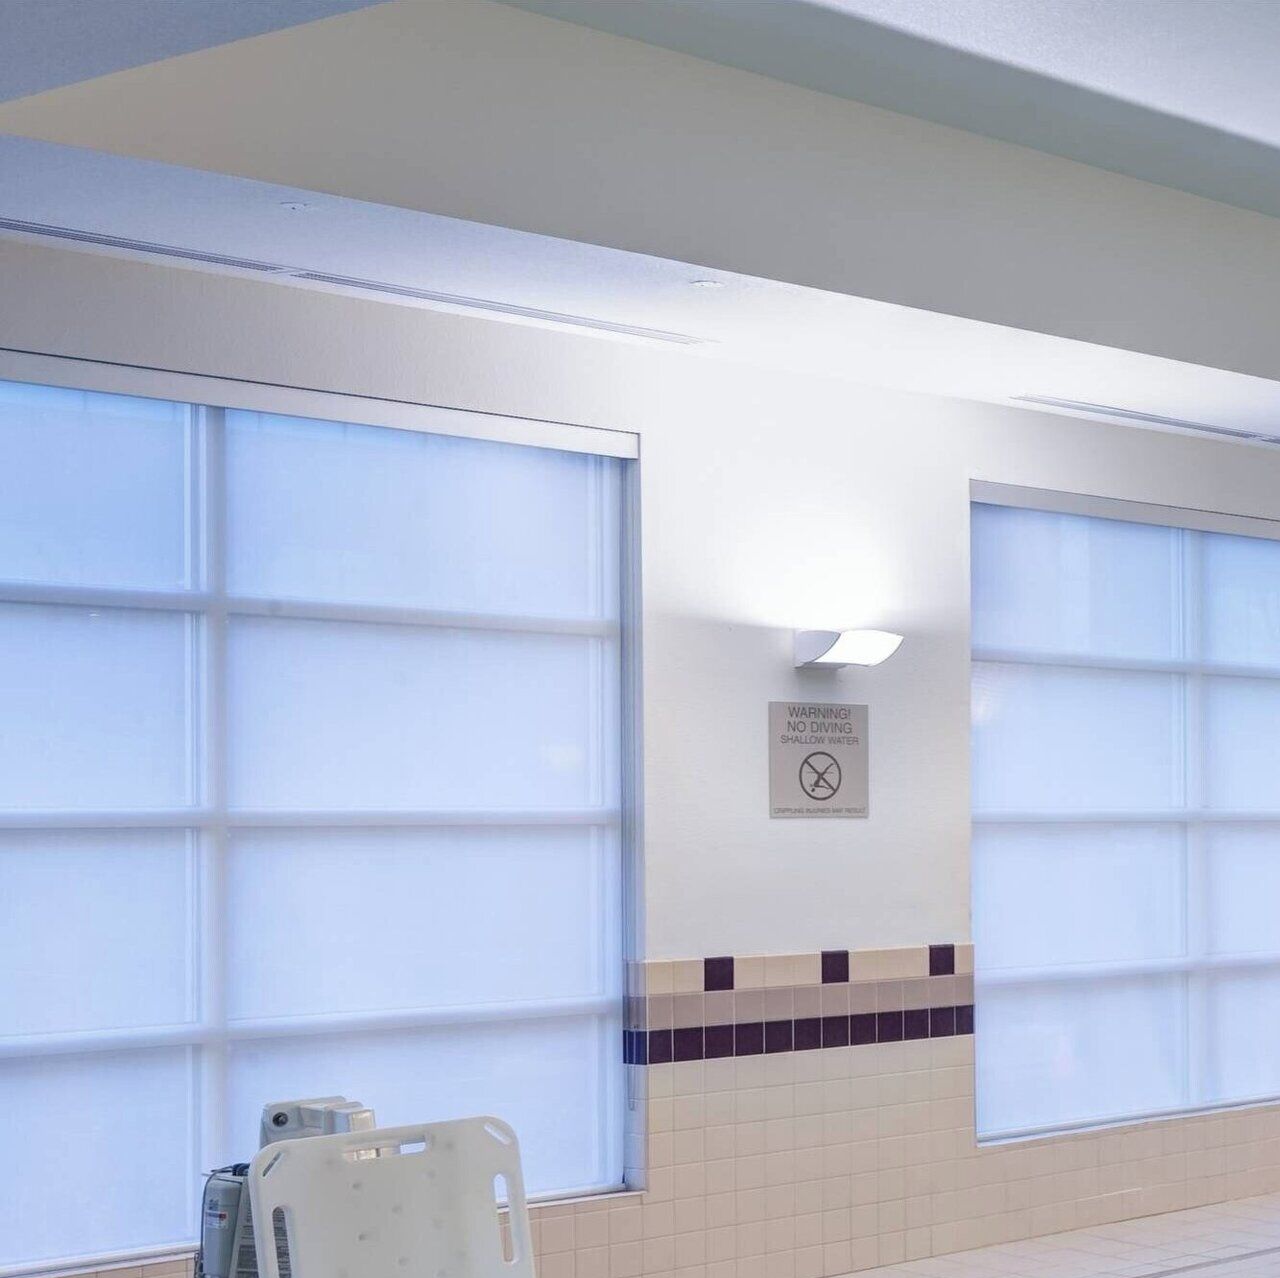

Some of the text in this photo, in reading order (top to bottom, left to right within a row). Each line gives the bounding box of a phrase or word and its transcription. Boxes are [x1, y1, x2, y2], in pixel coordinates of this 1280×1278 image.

[788, 706, 851, 719] WARNING!
[787, 721, 852, 734] NO DIVING
[780, 735, 860, 746] SHALLOW WATER
